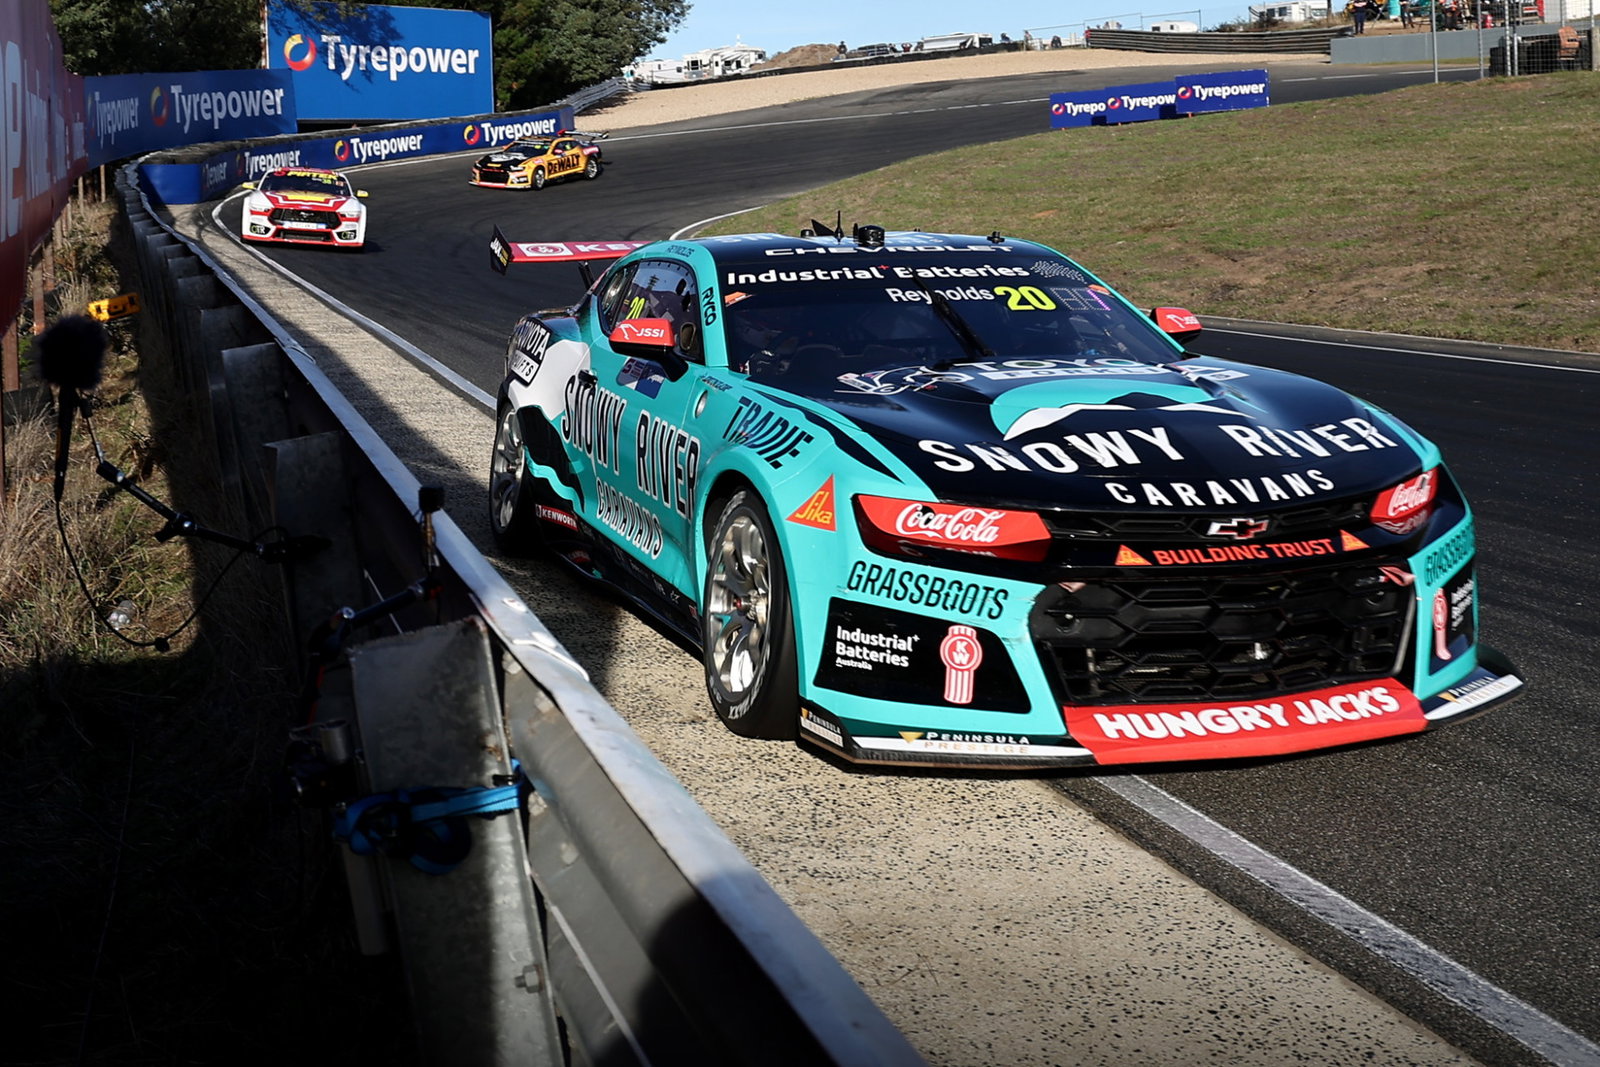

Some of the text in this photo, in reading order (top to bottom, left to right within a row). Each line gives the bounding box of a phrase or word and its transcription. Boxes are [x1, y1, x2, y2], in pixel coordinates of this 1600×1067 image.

[321, 34, 480, 81] Tyrepower
[1121, 95, 1176, 111] Tyrepow
[1191, 82, 1266, 99] Tyrepower
[94, 91, 140, 149] Tyrepower
[170, 84, 284, 135] Tyrepower
[1065, 101, 1107, 116] Tyrepo
[351, 133, 423, 163] Tyrepower
[481, 117, 556, 147] Tyrepower
[244, 149, 301, 180] Tyrepower
[702, 286, 717, 327] RYCO
[994, 286, 1057, 311] 20
[636, 327, 665, 338] JSSI
[561, 374, 627, 476] SNOWY
[636, 409, 700, 522] RIVER
[722, 396, 814, 470] TRADIE
[917, 417, 1398, 474] SNOWY RIVER
[1105, 469, 1335, 506] CARAVANS
[596, 476, 663, 560] CARAVANS
[795, 490, 833, 525] Sika
[895, 503, 1006, 543] Coca-Cola
[1153, 545, 1263, 566] BUILDING
[1266, 538, 1337, 559] TRUST
[836, 641, 909, 668] Batteries
[1093, 686, 1400, 740] HUNGRY JACK'S
[926, 731, 1030, 745] PENINSULA
